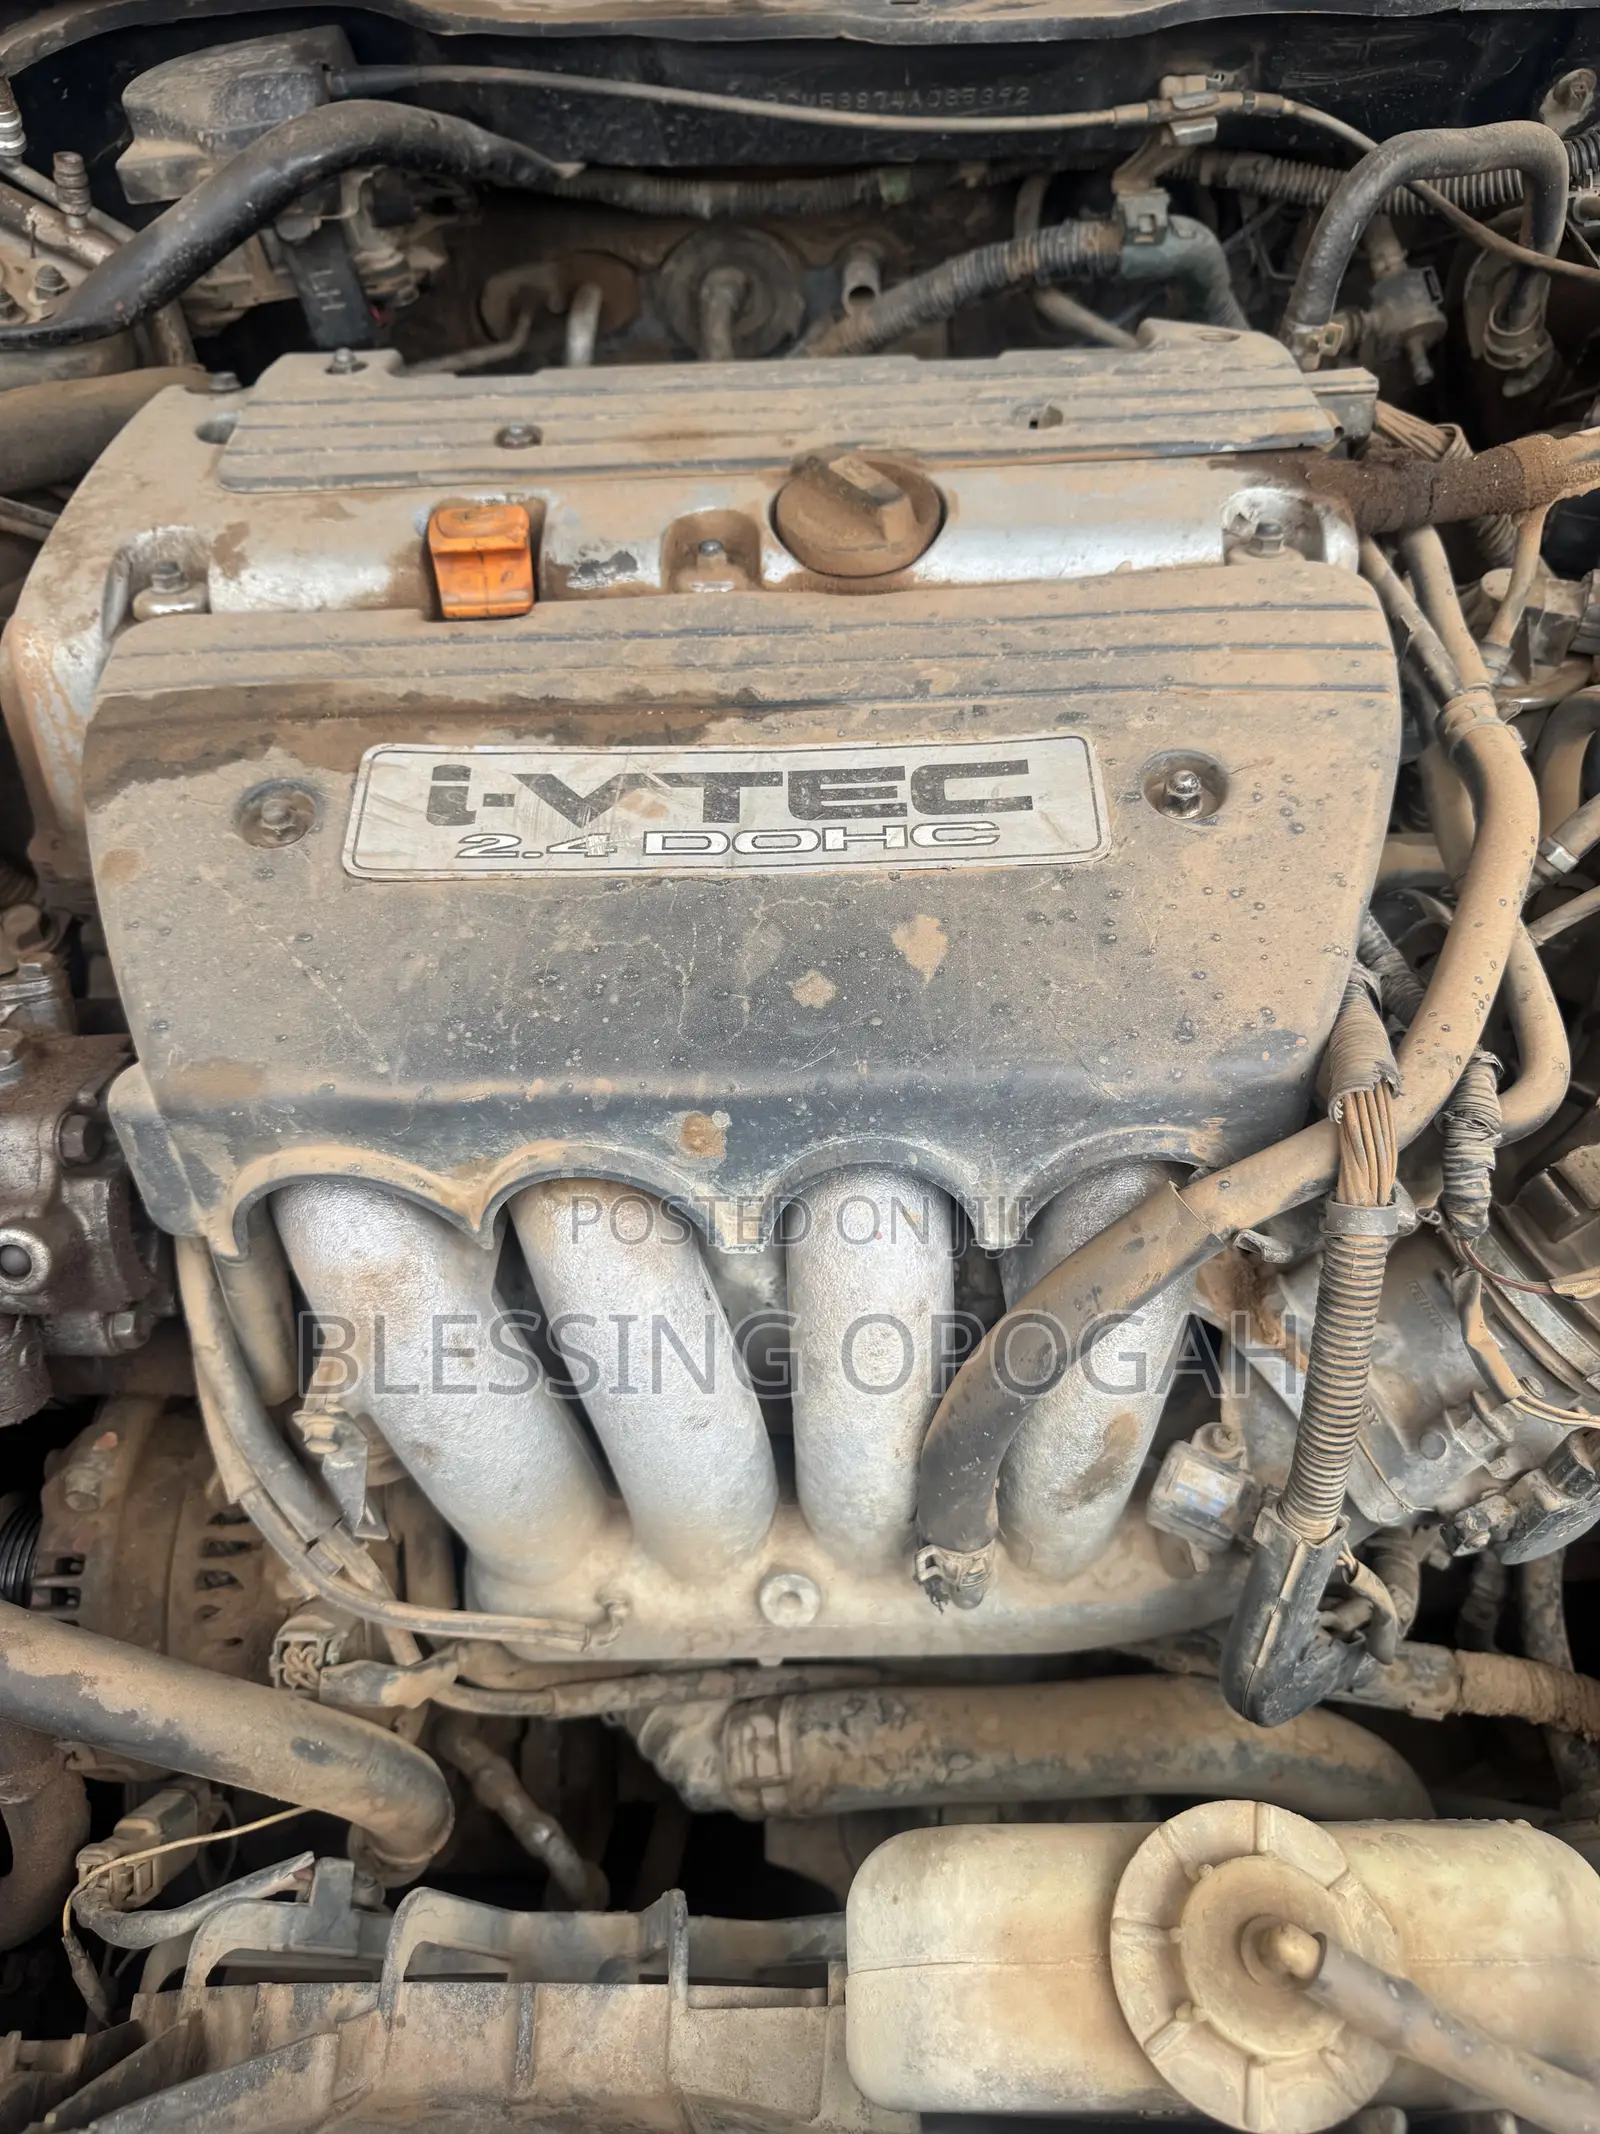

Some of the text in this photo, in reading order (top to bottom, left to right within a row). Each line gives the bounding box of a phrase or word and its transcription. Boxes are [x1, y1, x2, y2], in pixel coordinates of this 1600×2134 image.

[426, 759, 1034, 827] i-VTEC
[456, 821, 1001, 859] 2.4 DOHC
